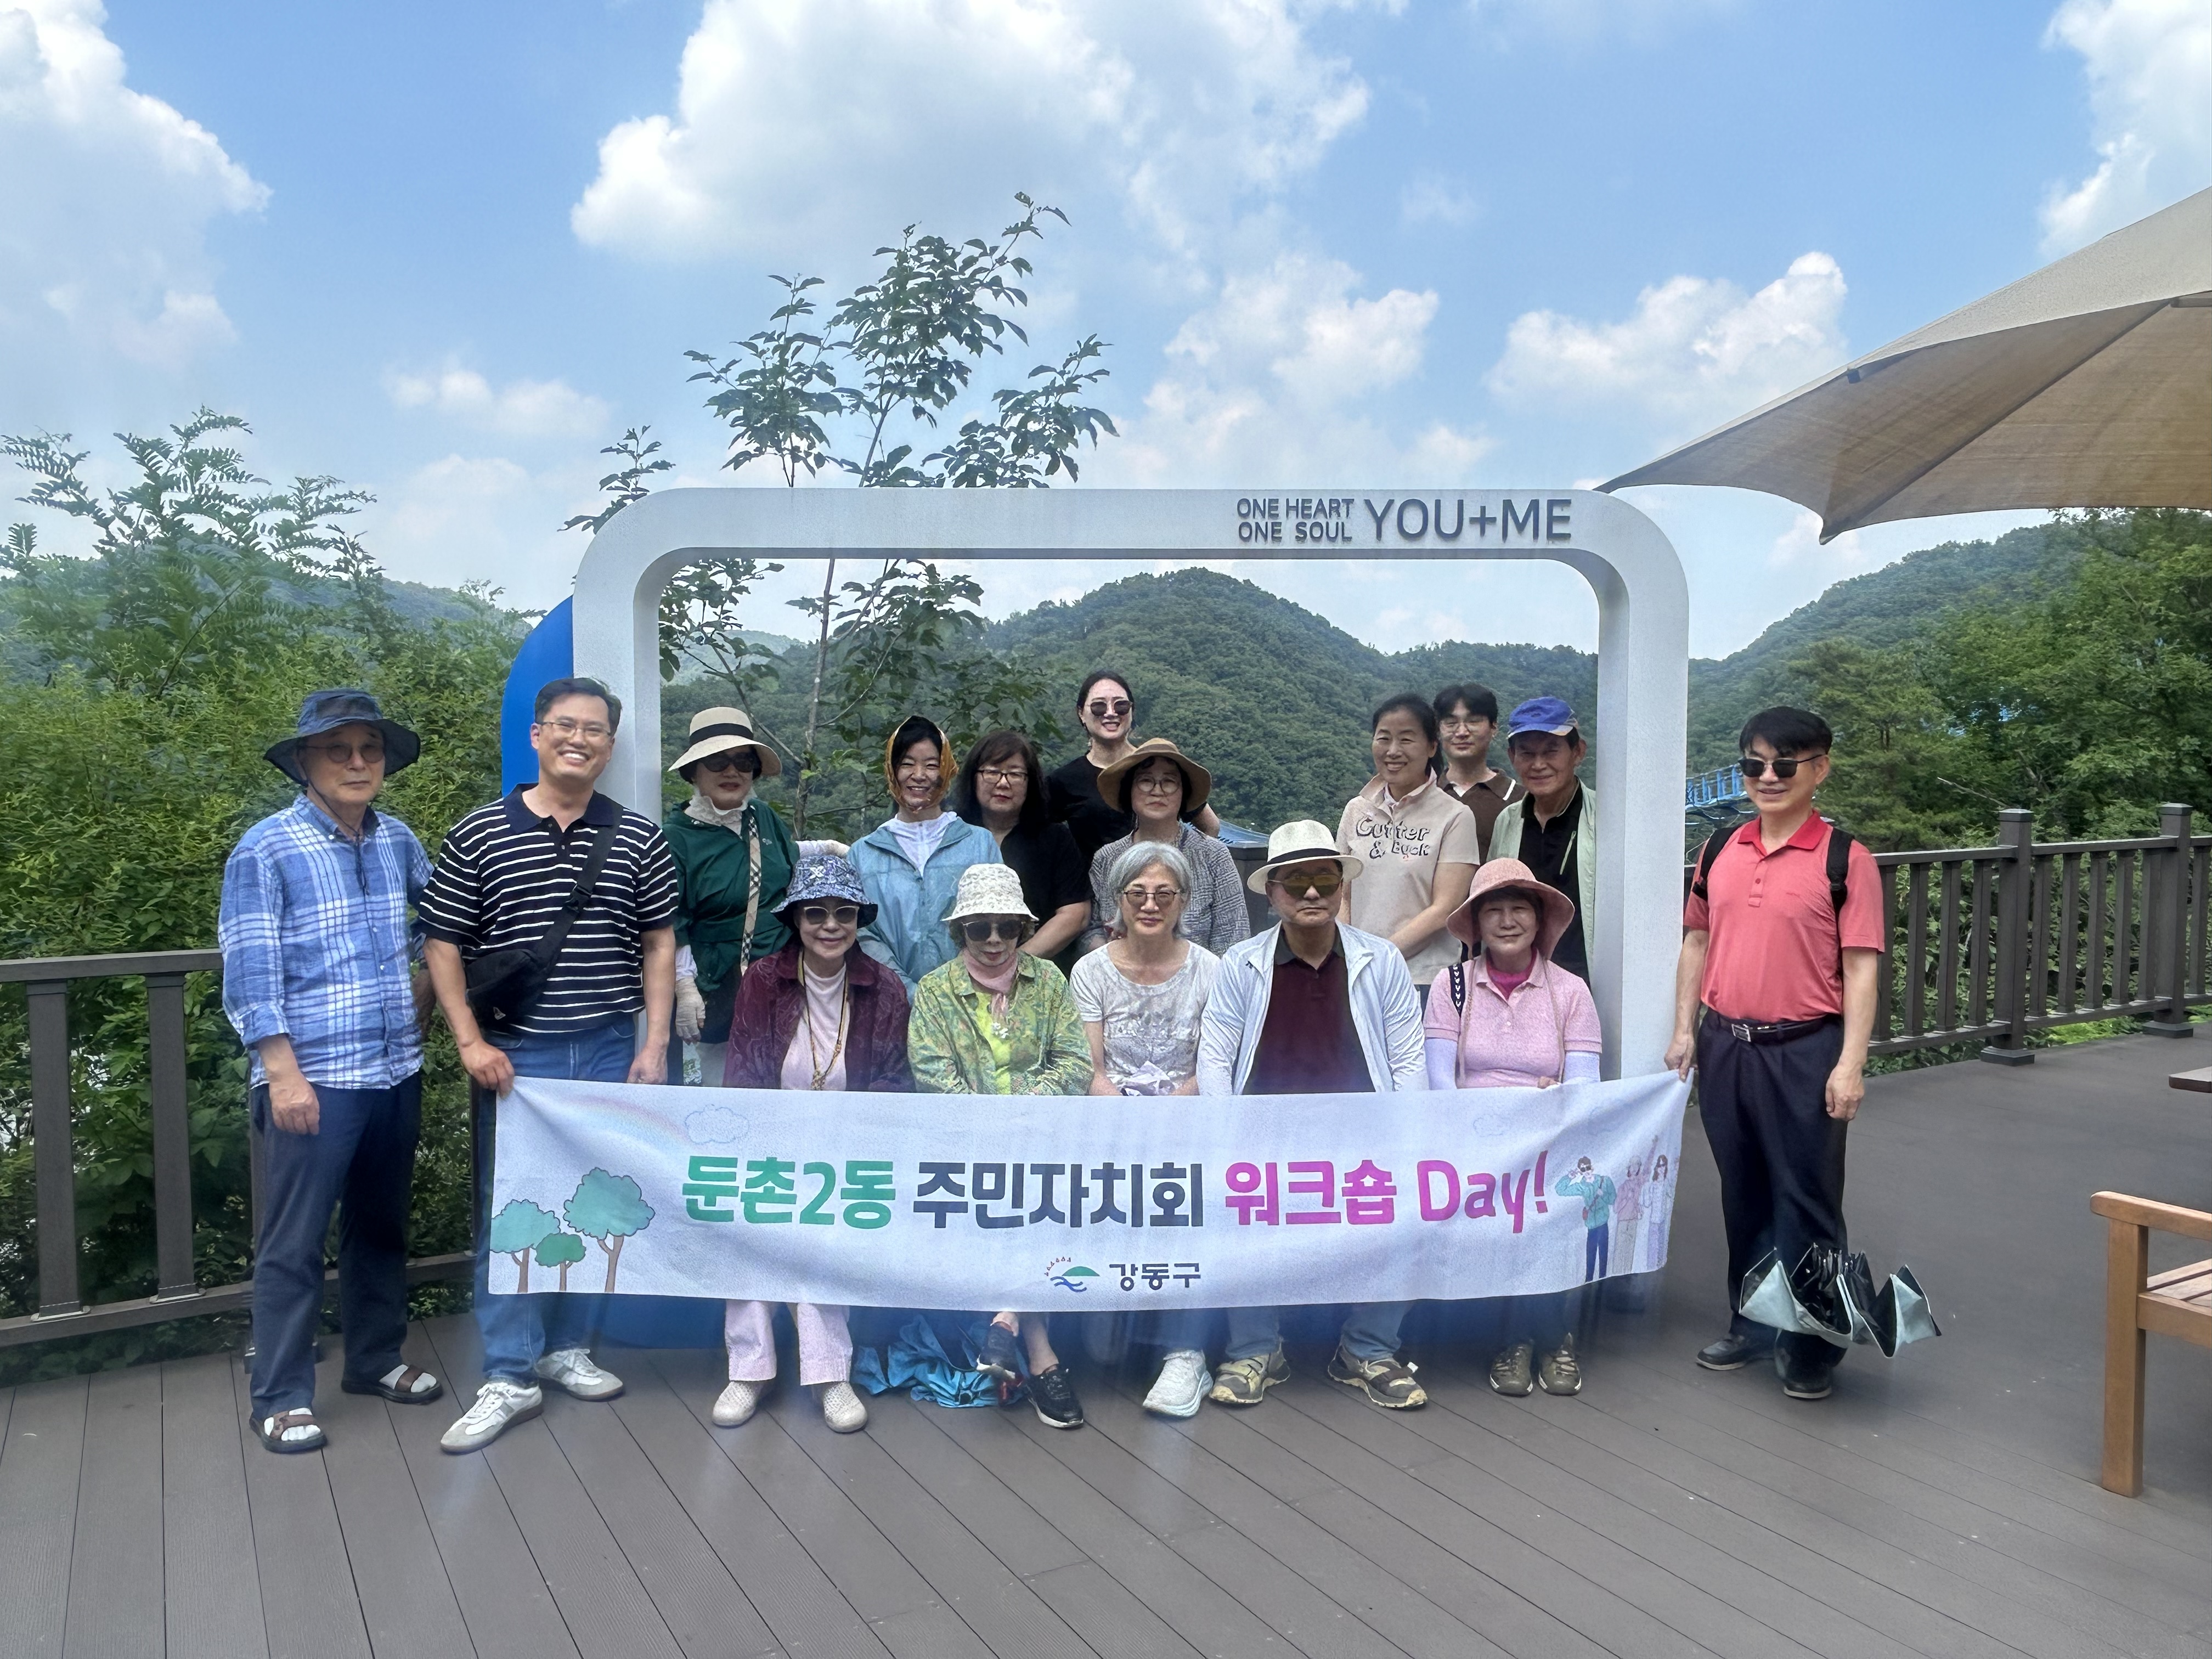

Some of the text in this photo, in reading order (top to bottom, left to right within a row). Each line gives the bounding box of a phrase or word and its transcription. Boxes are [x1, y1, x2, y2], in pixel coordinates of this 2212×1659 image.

[1237, 498, 1355, 520] ONE HEART
[1364, 498, 1572, 543] YOU+ME
[1238, 521, 1352, 543] ONE SOUL
[1356, 816, 1431, 841] Cutter
[682, 1150, 1548, 1234] 둔촌2동 주민자치회 워크숍 Day!
[1109, 1262, 1201, 1292] 강동구
